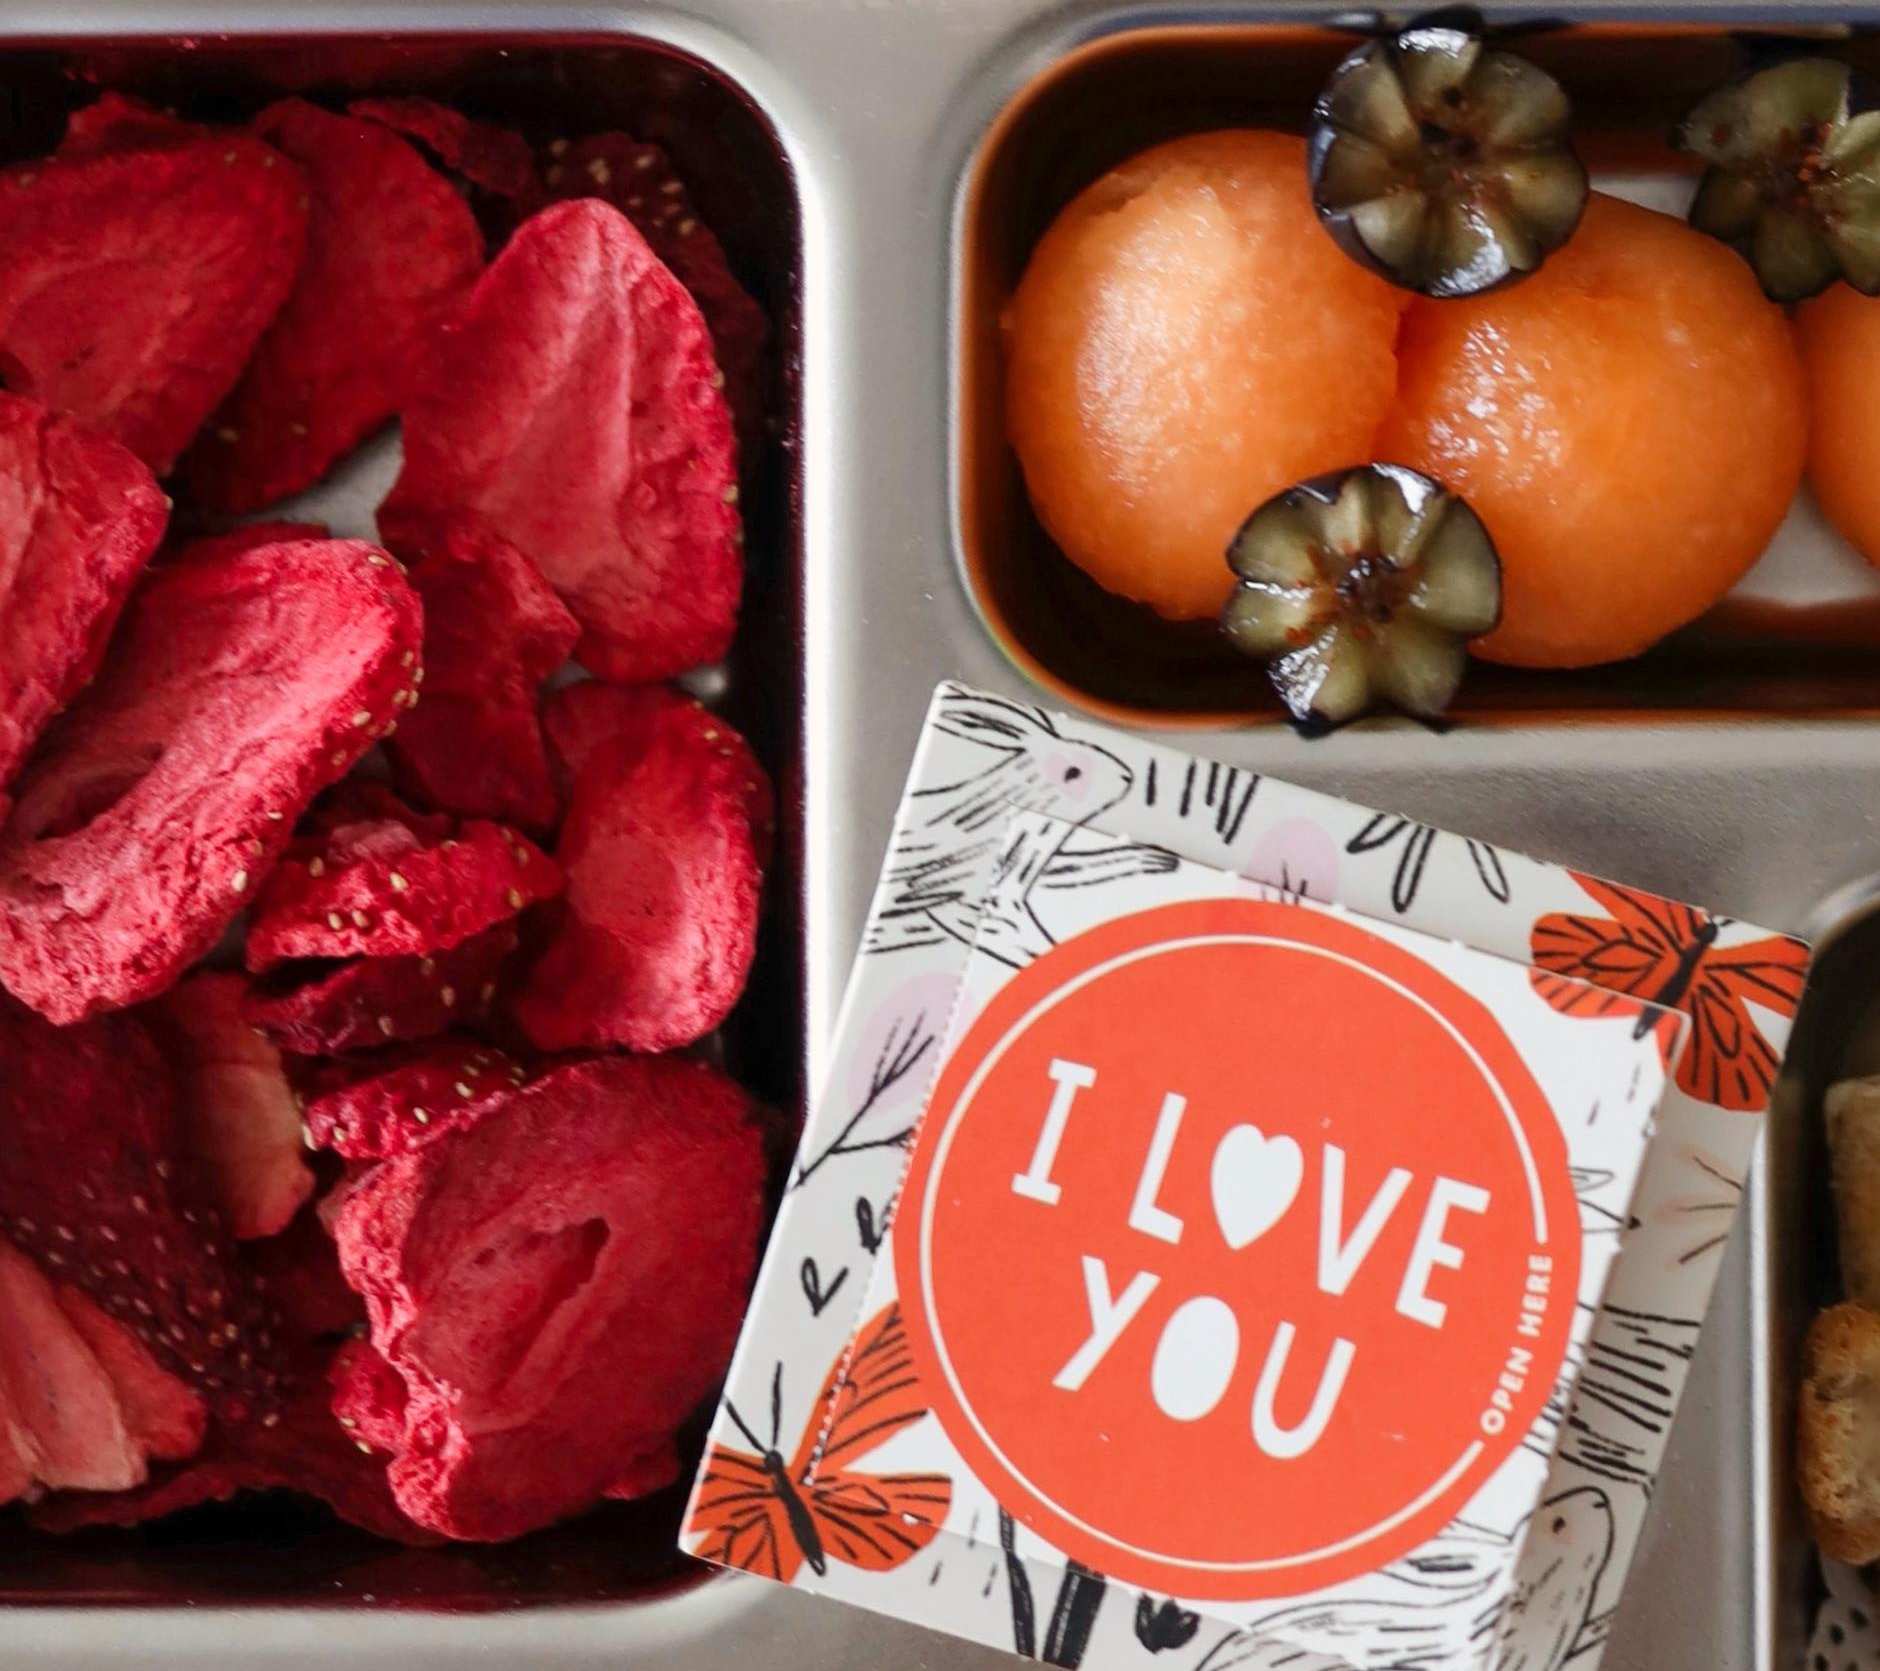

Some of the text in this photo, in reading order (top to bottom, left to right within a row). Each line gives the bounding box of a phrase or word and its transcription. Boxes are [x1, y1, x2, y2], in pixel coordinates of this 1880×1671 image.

[1011, 1057, 1097, 1206] I
[1053, 1253, 1356, 1462] YOU
[1480, 1254, 1553, 1436] OPEN HERE
